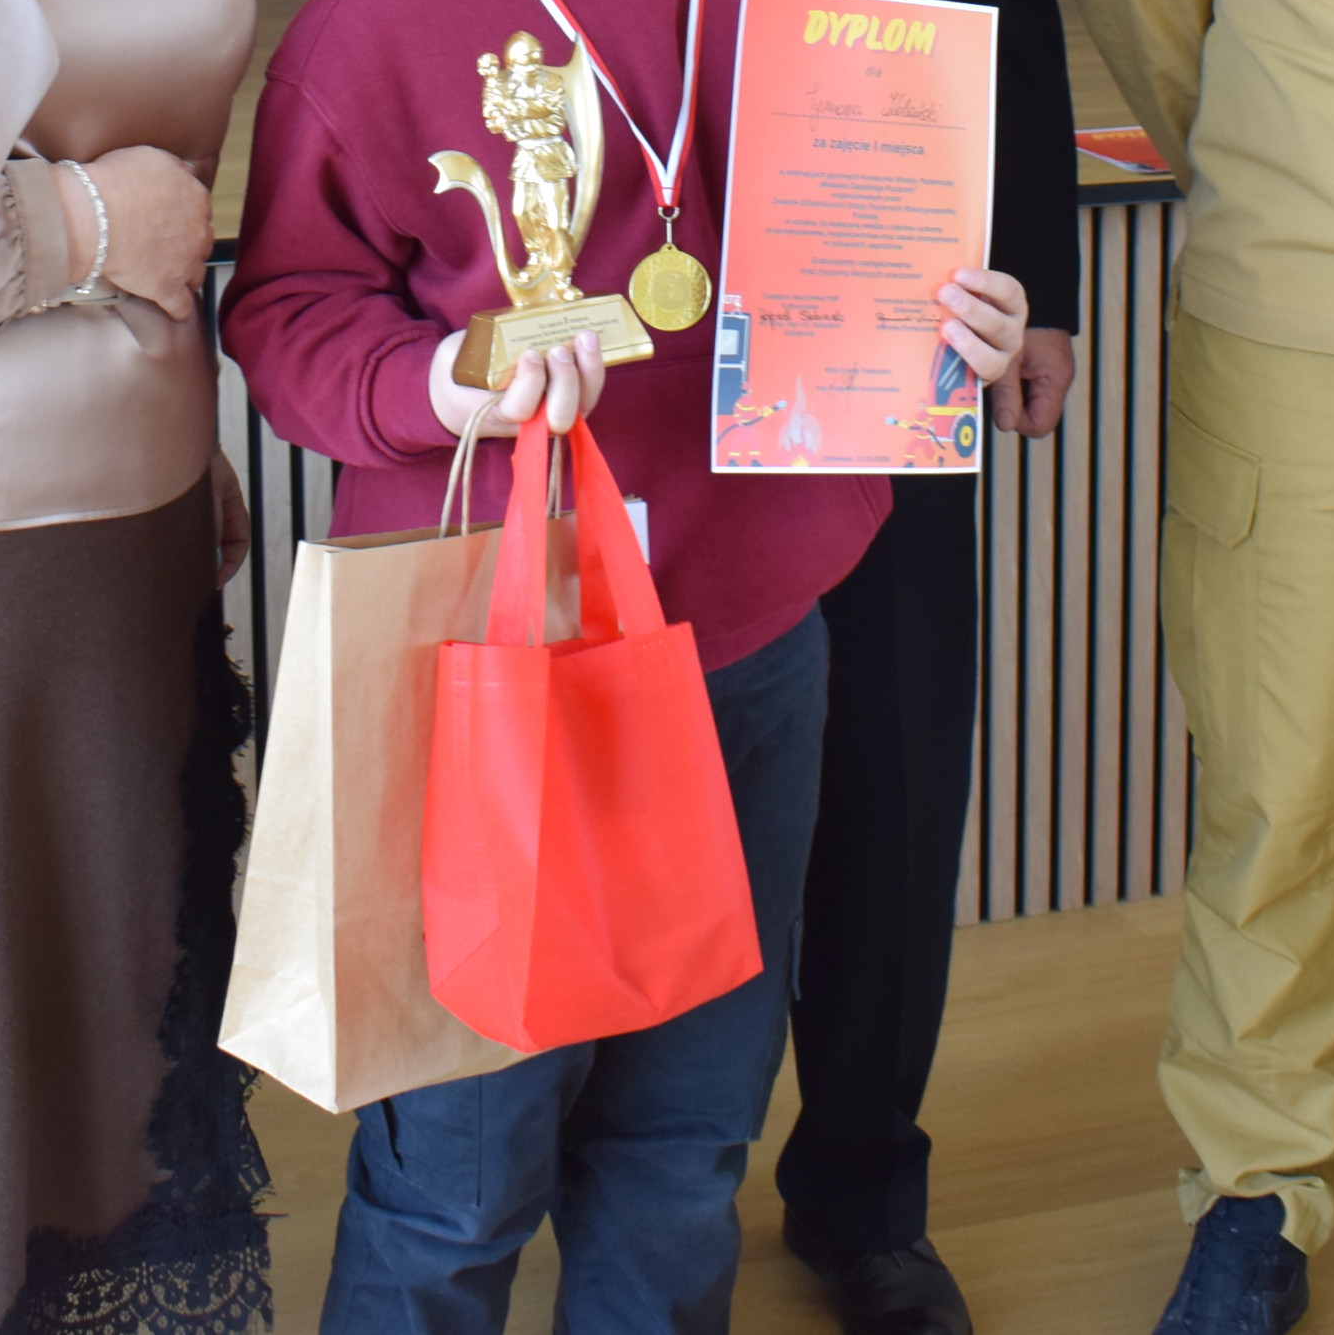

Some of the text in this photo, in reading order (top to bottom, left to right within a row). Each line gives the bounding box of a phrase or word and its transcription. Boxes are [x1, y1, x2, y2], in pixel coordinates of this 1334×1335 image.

[803, 9, 937, 56] DYPLOM
[813, 138, 826, 148] za
[881, 141, 925, 156] miejsca
